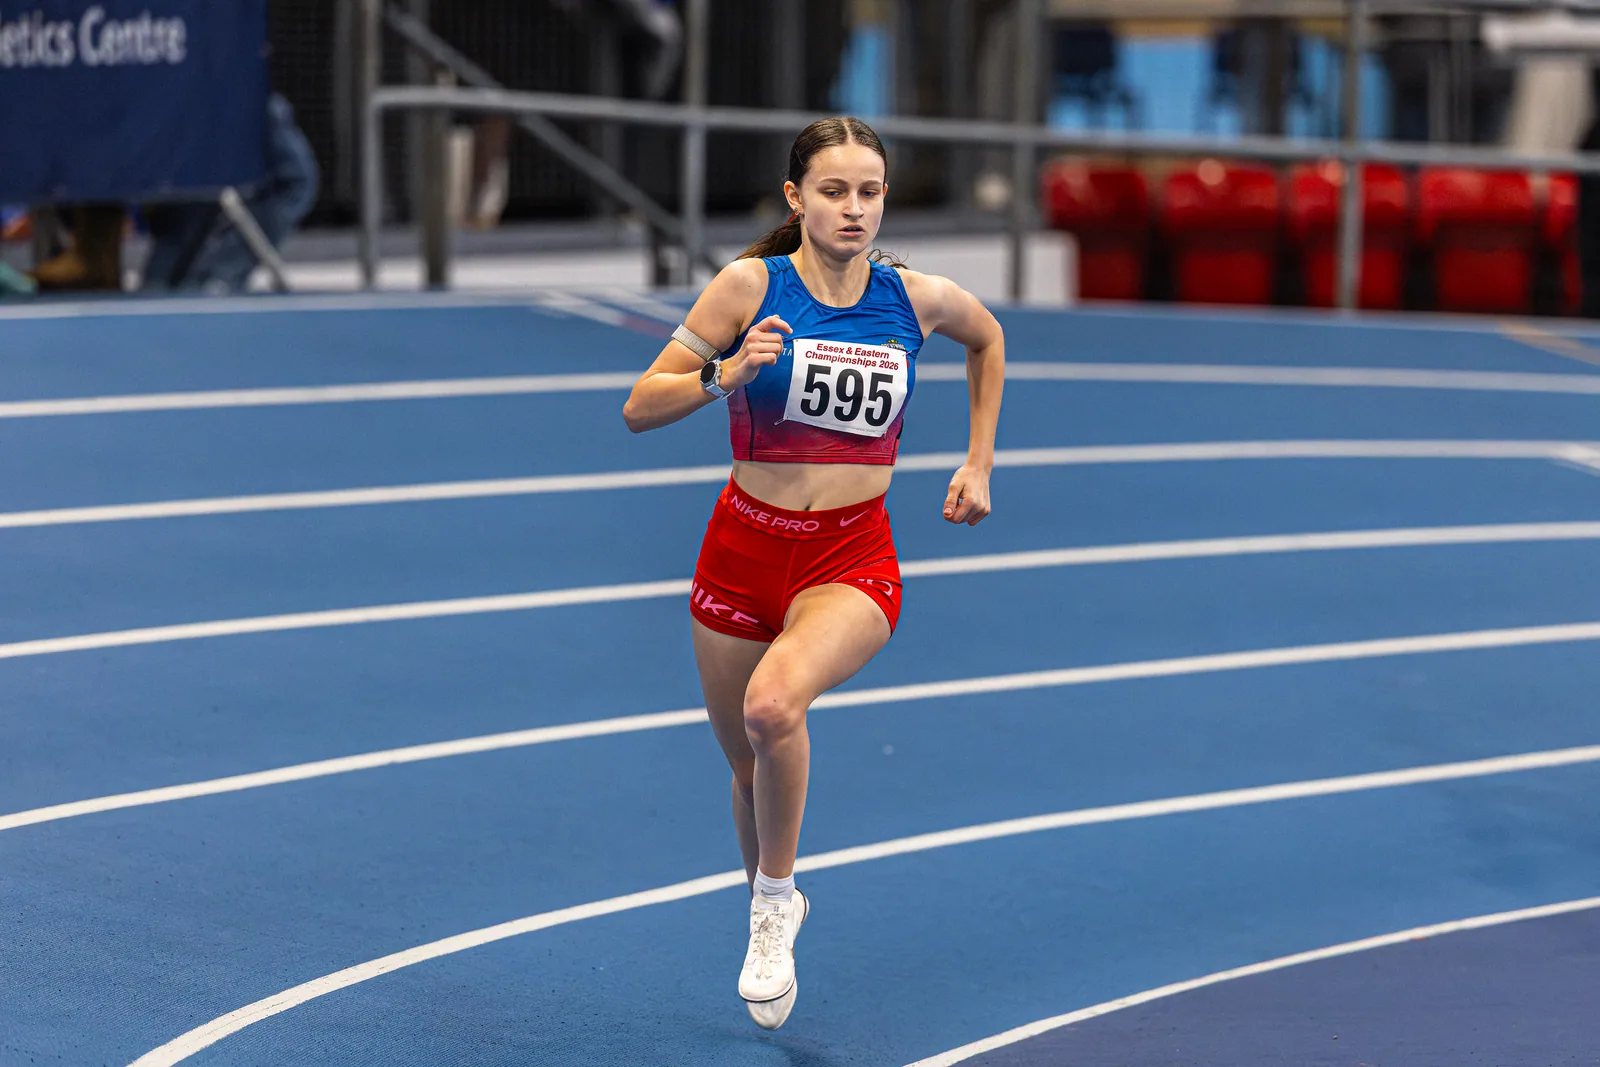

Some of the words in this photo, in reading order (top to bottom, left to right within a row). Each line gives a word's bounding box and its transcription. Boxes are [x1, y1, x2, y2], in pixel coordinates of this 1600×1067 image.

[0, 9, 75, 67] etics
[78, 6, 187, 65] Centre
[805, 351, 877, 368] Championships
[878, 360, 900, 370] 2026
[816, 343, 844, 355] Essex
[846, 347, 854, 355] &
[854, 347, 890, 359] Eastern
[800, 363, 893, 427] 595
[731, 495, 771, 524] NIKE
[771, 517, 820, 531] PRO
